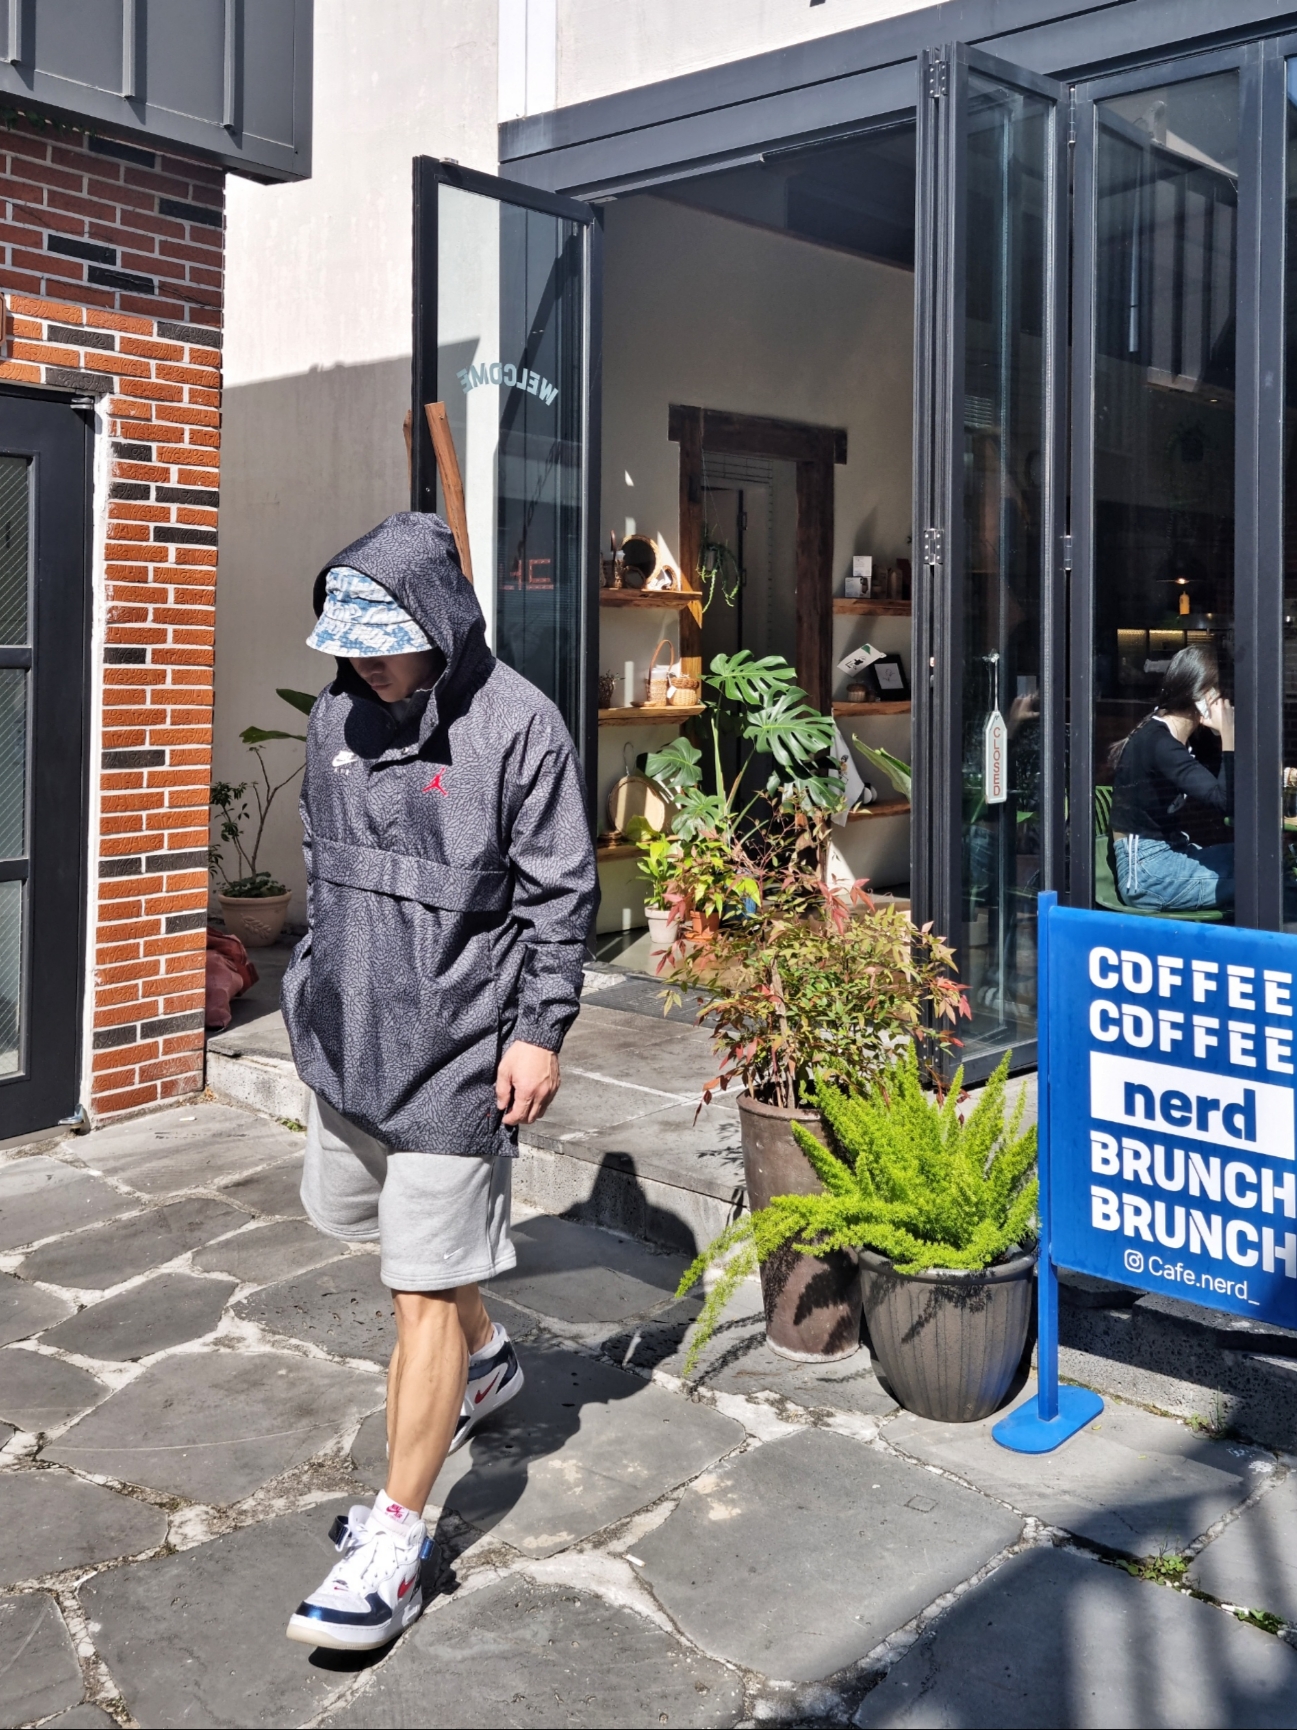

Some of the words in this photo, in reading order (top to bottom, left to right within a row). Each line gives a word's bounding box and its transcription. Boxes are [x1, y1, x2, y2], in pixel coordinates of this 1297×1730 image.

[993, 726, 1001, 797] CLOSED
[1089, 946, 1293, 1017] COFFEE
[1089, 999, 1294, 1075] COFFEE
[1124, 1080, 1257, 1142] nerd
[1090, 1129, 1297, 1219] BRUNCH
[1090, 1184, 1297, 1279] BRUNCH
[1148, 1255, 1261, 1306] Cafe.nerd_
